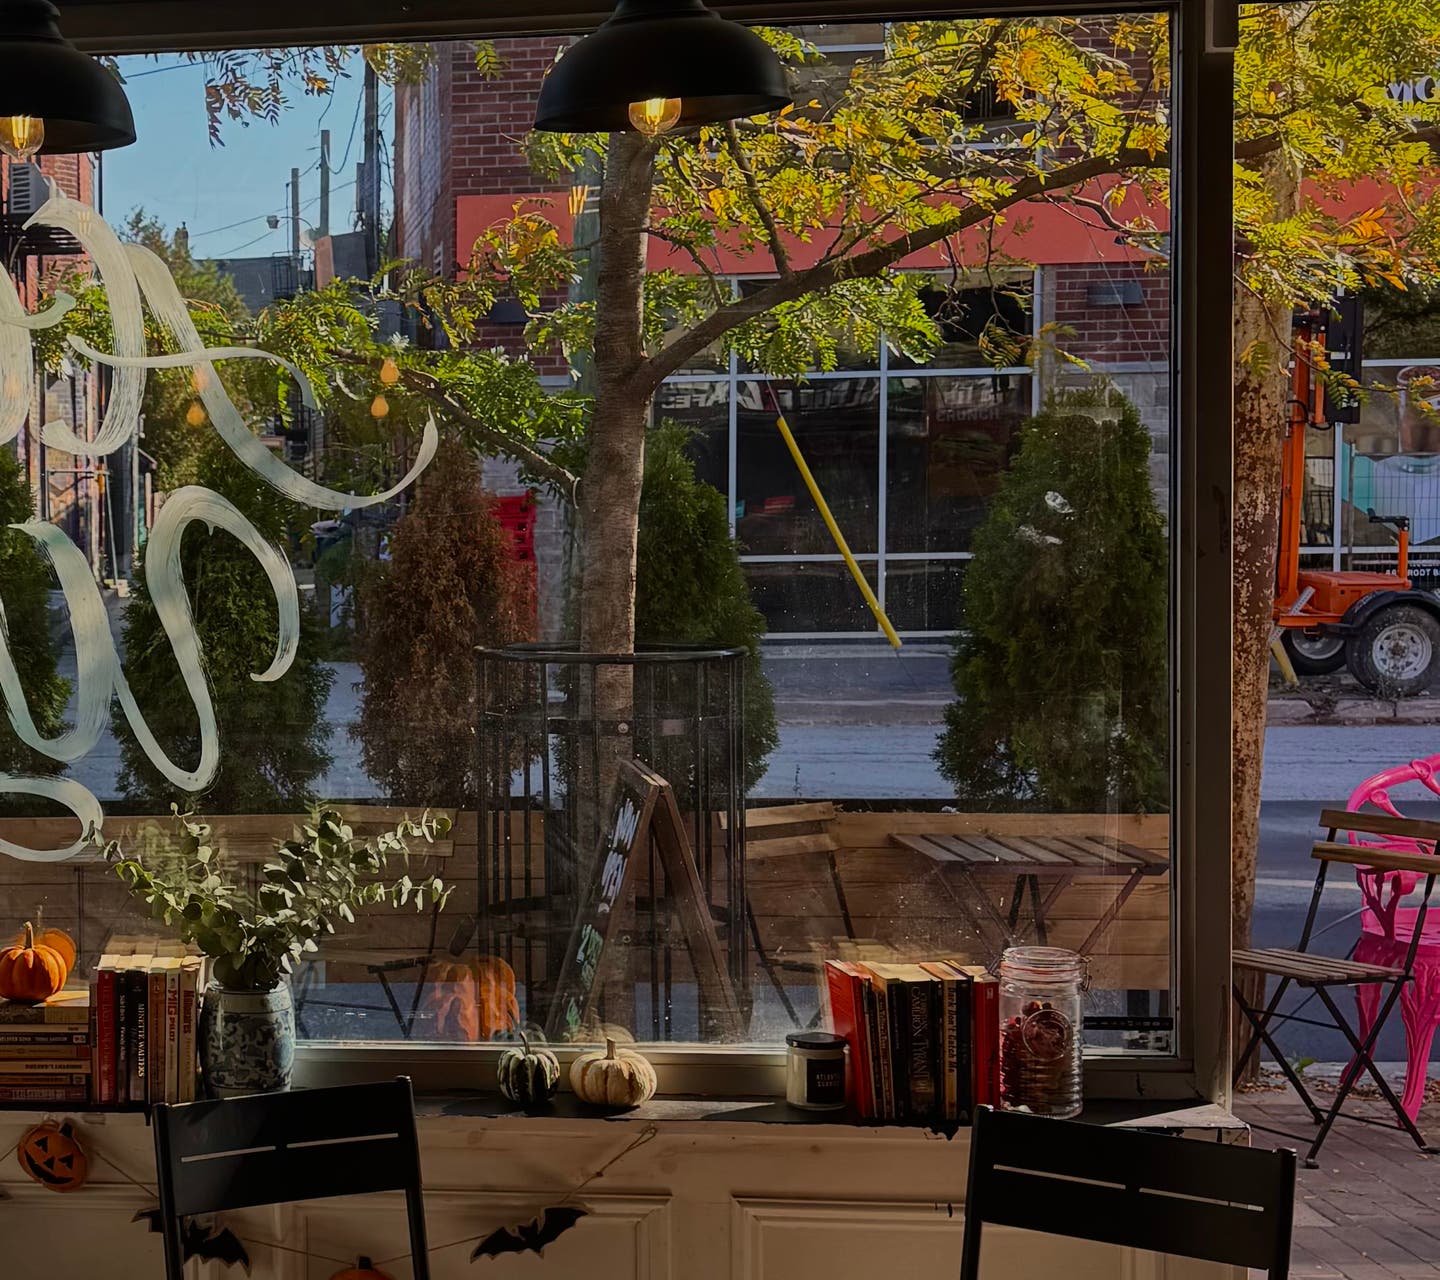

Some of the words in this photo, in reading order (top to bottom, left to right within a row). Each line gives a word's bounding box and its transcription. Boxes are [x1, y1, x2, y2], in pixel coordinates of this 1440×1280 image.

[947, 987, 958, 1007] Dark
[137, 1002, 145, 1040] MINETTE
[183, 990, 194, 1034] Millionaires
[947, 1009, 958, 1031] Don't
[947, 1034, 957, 1058] Catch
[137, 1041, 145, 1078] WALTERS
[947, 1060, 957, 1074] Me
